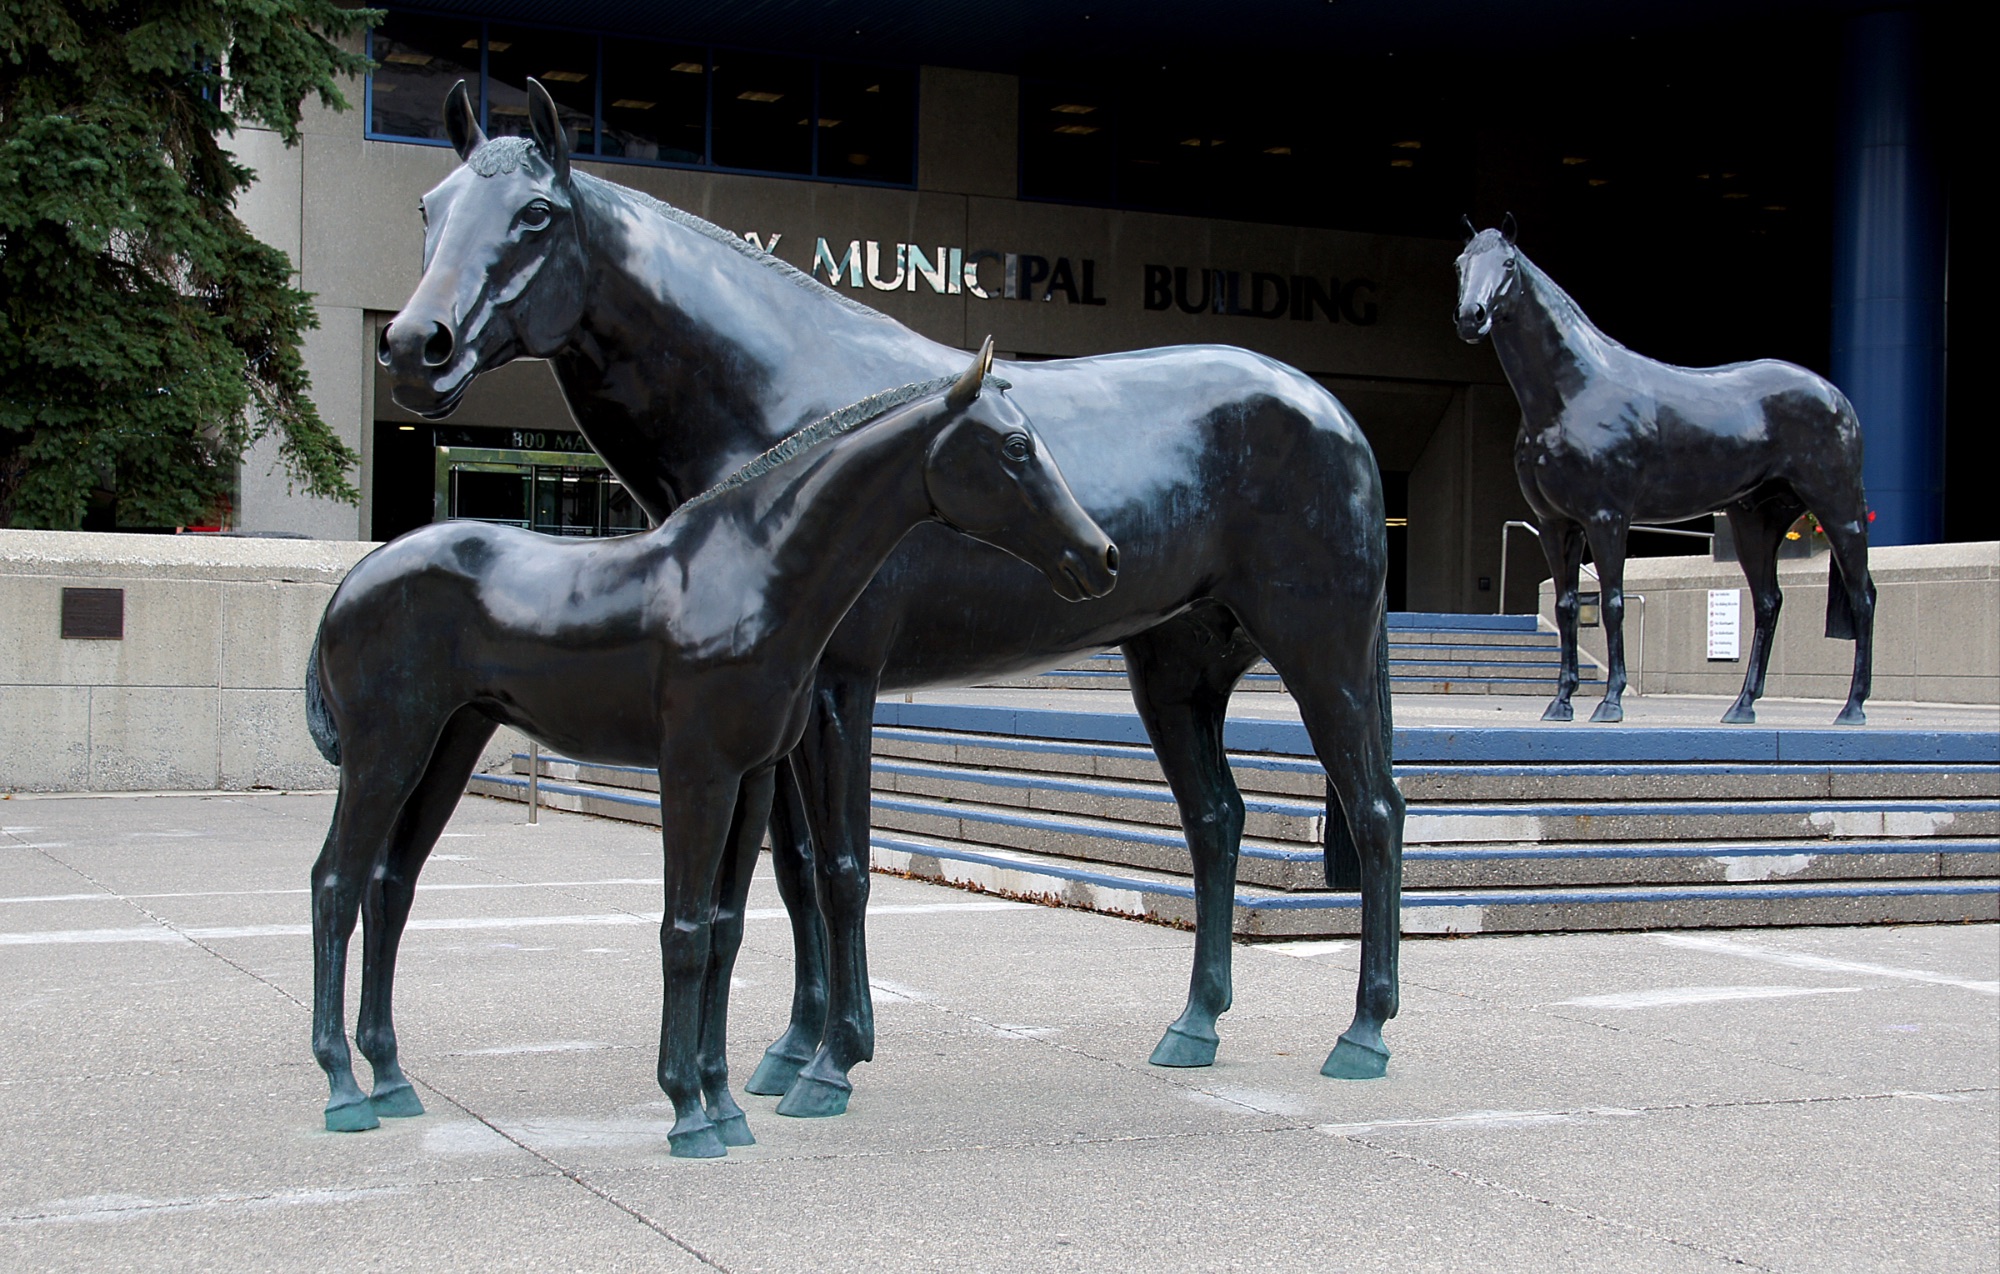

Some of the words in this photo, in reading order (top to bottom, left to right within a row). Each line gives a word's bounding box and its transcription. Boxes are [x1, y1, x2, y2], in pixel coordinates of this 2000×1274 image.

[812, 236, 1106, 306] MUNICIPAL
[1144, 264, 1377, 326] BUILDING
[511, 431, 546, 449] 800
